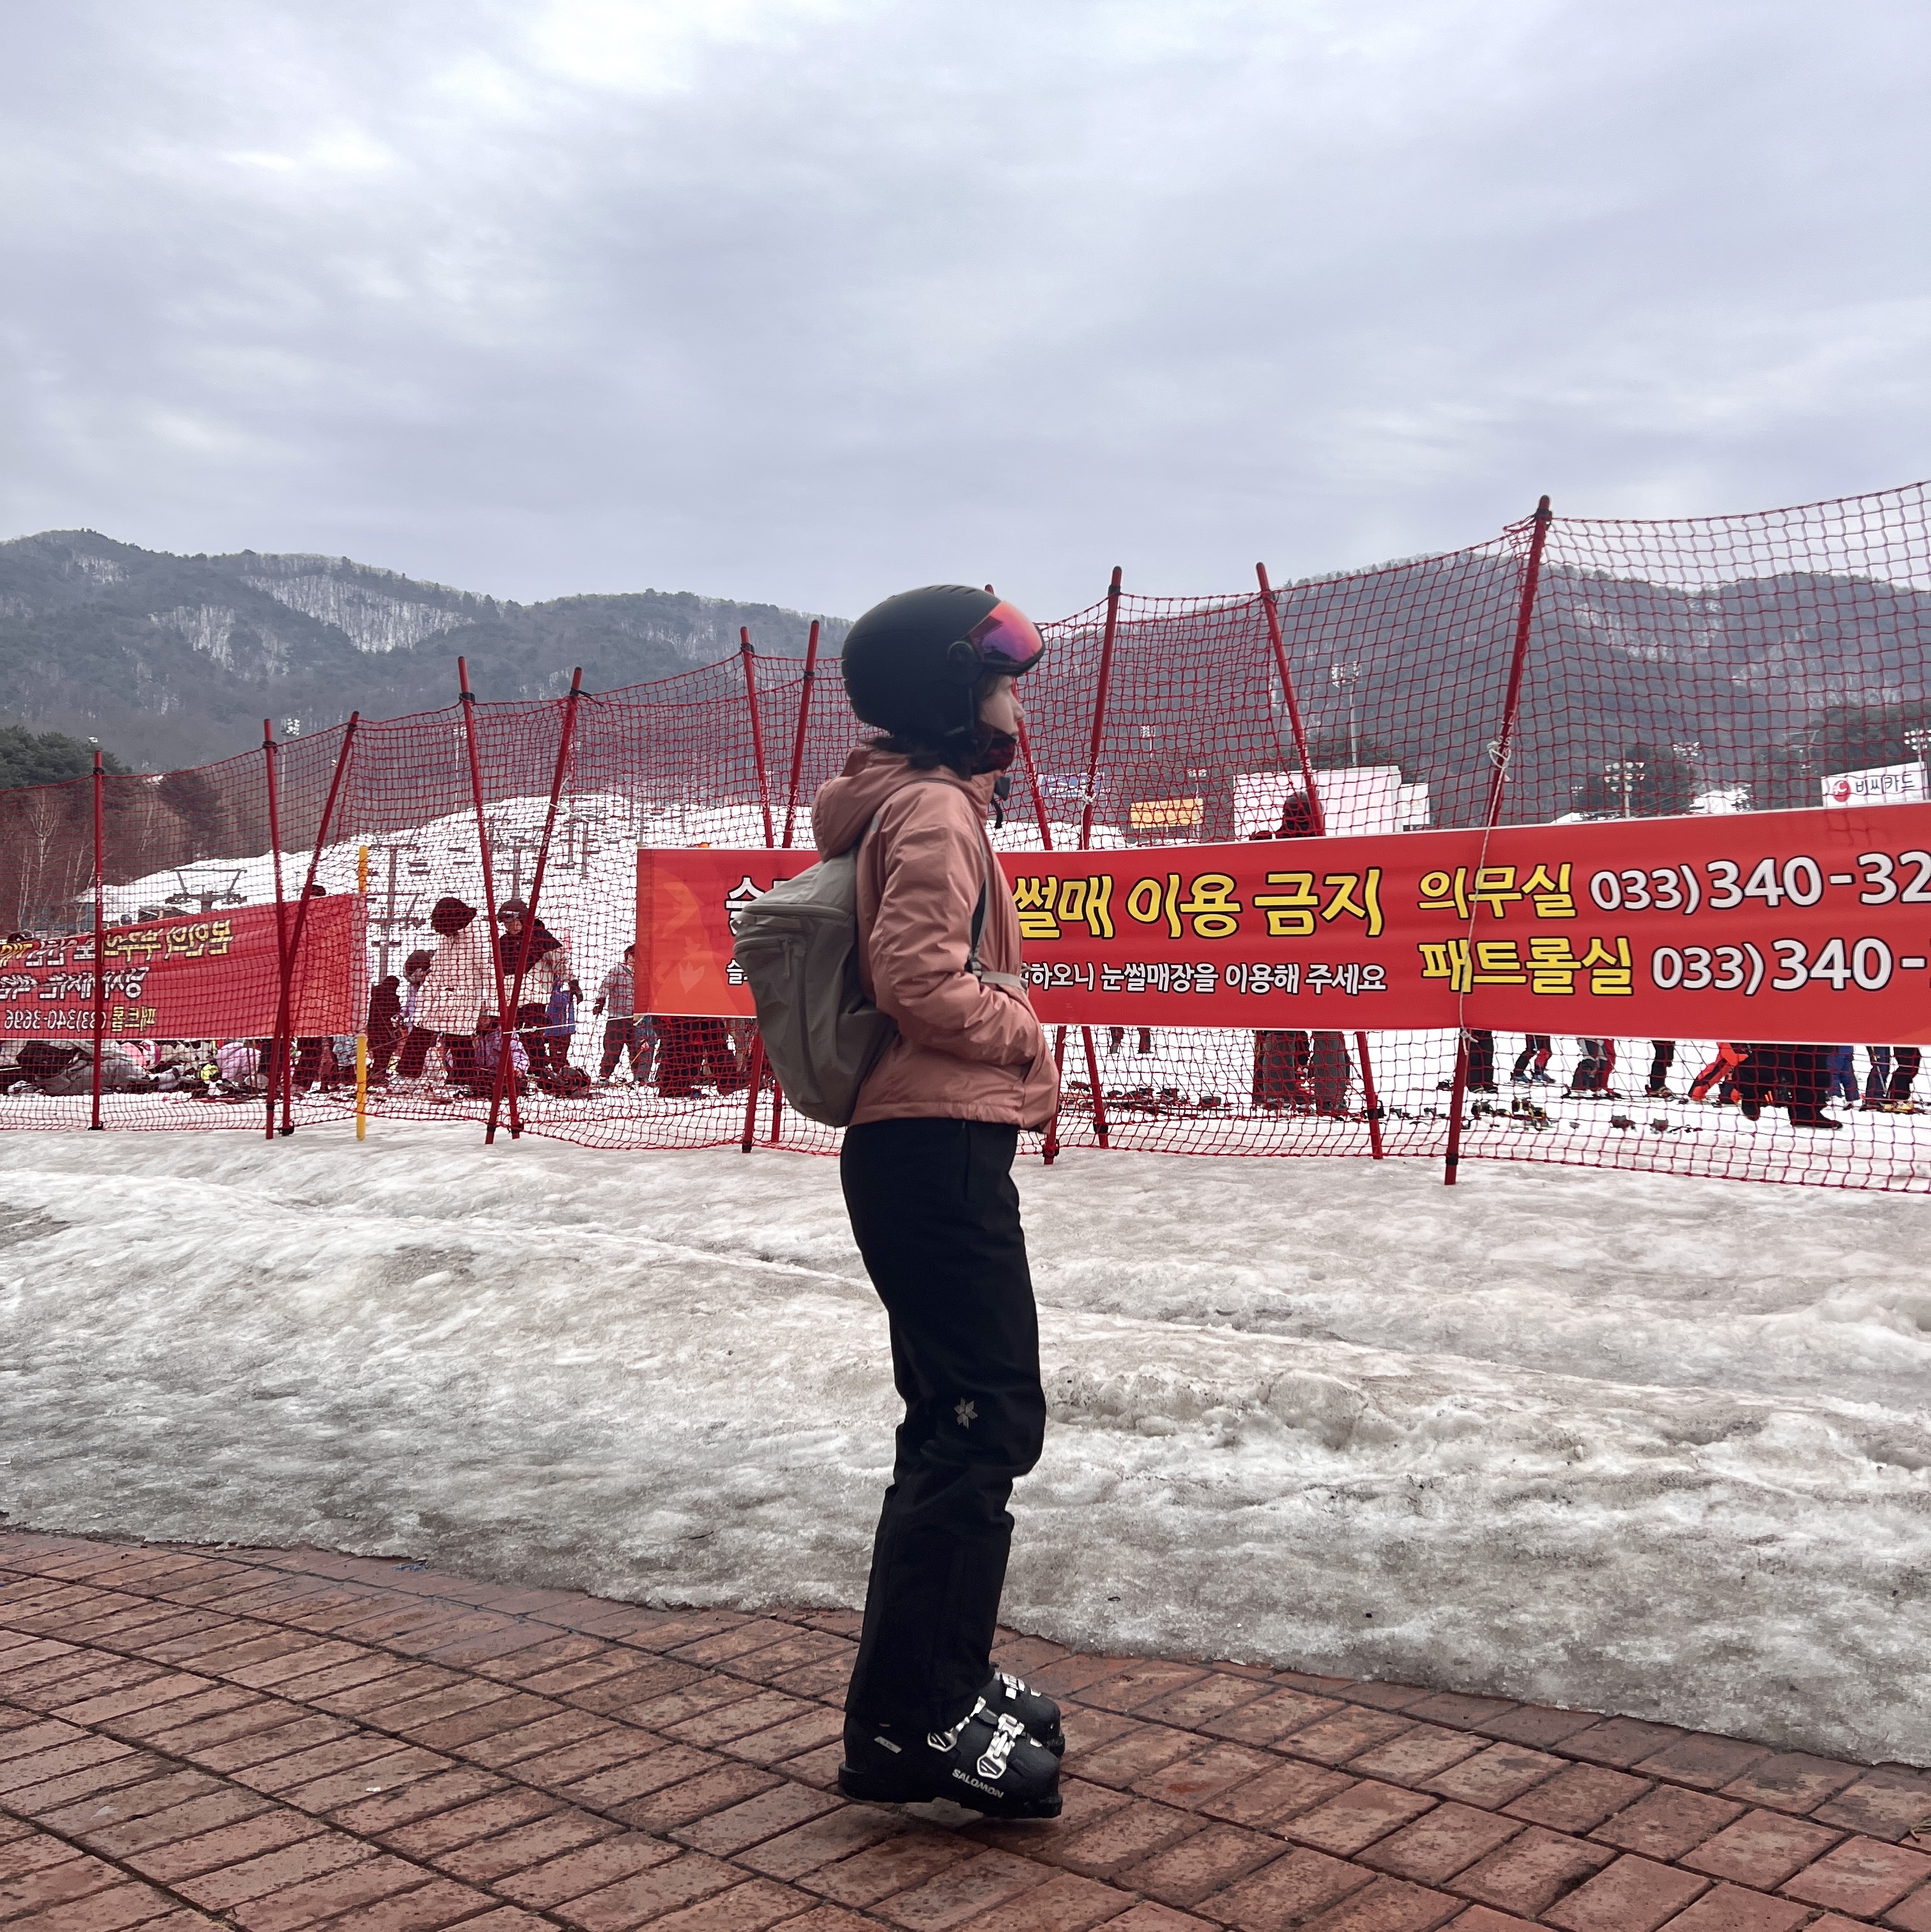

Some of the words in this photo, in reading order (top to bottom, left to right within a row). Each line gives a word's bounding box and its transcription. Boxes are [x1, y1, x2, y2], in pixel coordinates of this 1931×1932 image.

[1856, 774, 1915, 794] 비씨카드
[1012, 875, 1114, 938] 썰매
[1127, 873, 1242, 939] 이용
[1253, 868, 1383, 937] 금지
[1417, 863, 1578, 919] 의무실
[1101, 963, 1219, 993] 눈썰매장을
[1225, 963, 1299, 994] 이용해
[1305, 963, 1386, 994] 주세요
[1418, 937, 1633, 994] 패트롤실
[952, 1768, 1005, 1799] SALOMON
